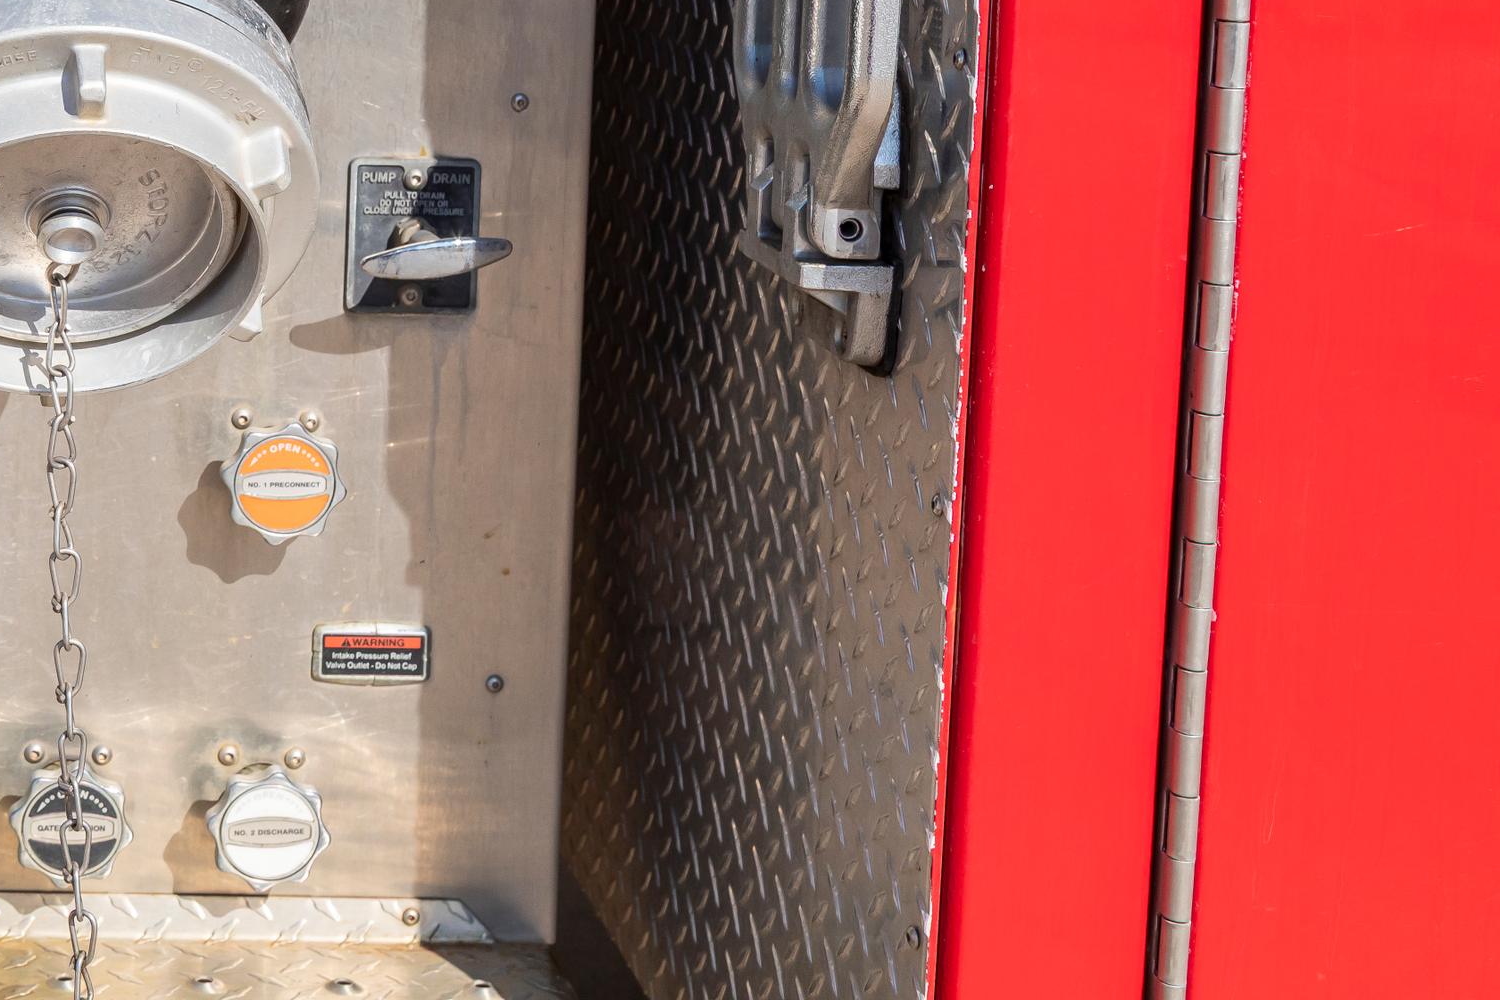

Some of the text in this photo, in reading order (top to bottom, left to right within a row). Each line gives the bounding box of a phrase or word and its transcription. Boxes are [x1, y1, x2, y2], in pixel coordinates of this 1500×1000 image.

[362, 171, 471, 184] PUMP DRAIN
[384, 191, 406, 200] PULL
[407, 191, 419, 199] TO
[135, 167, 169, 243] STORZ
[380, 199, 392, 207] DO
[394, 199, 411, 207] NOT
[363, 206, 390, 215] CLOSE
[269, 442, 301, 454] OPEN
[352, 638, 405, 647] WARNING
[331, 651, 412, 660] Intake Pressure Relief
[325, 661, 346, 669] Valve
[346, 661, 370, 669] Outlet
[375, 661, 386, 670] Do
[387, 661, 401, 670] Not
[402, 662, 418, 672] Cap
[37, 824, 61, 832] GATE
[258, 828, 304, 836] DISCHARGE
